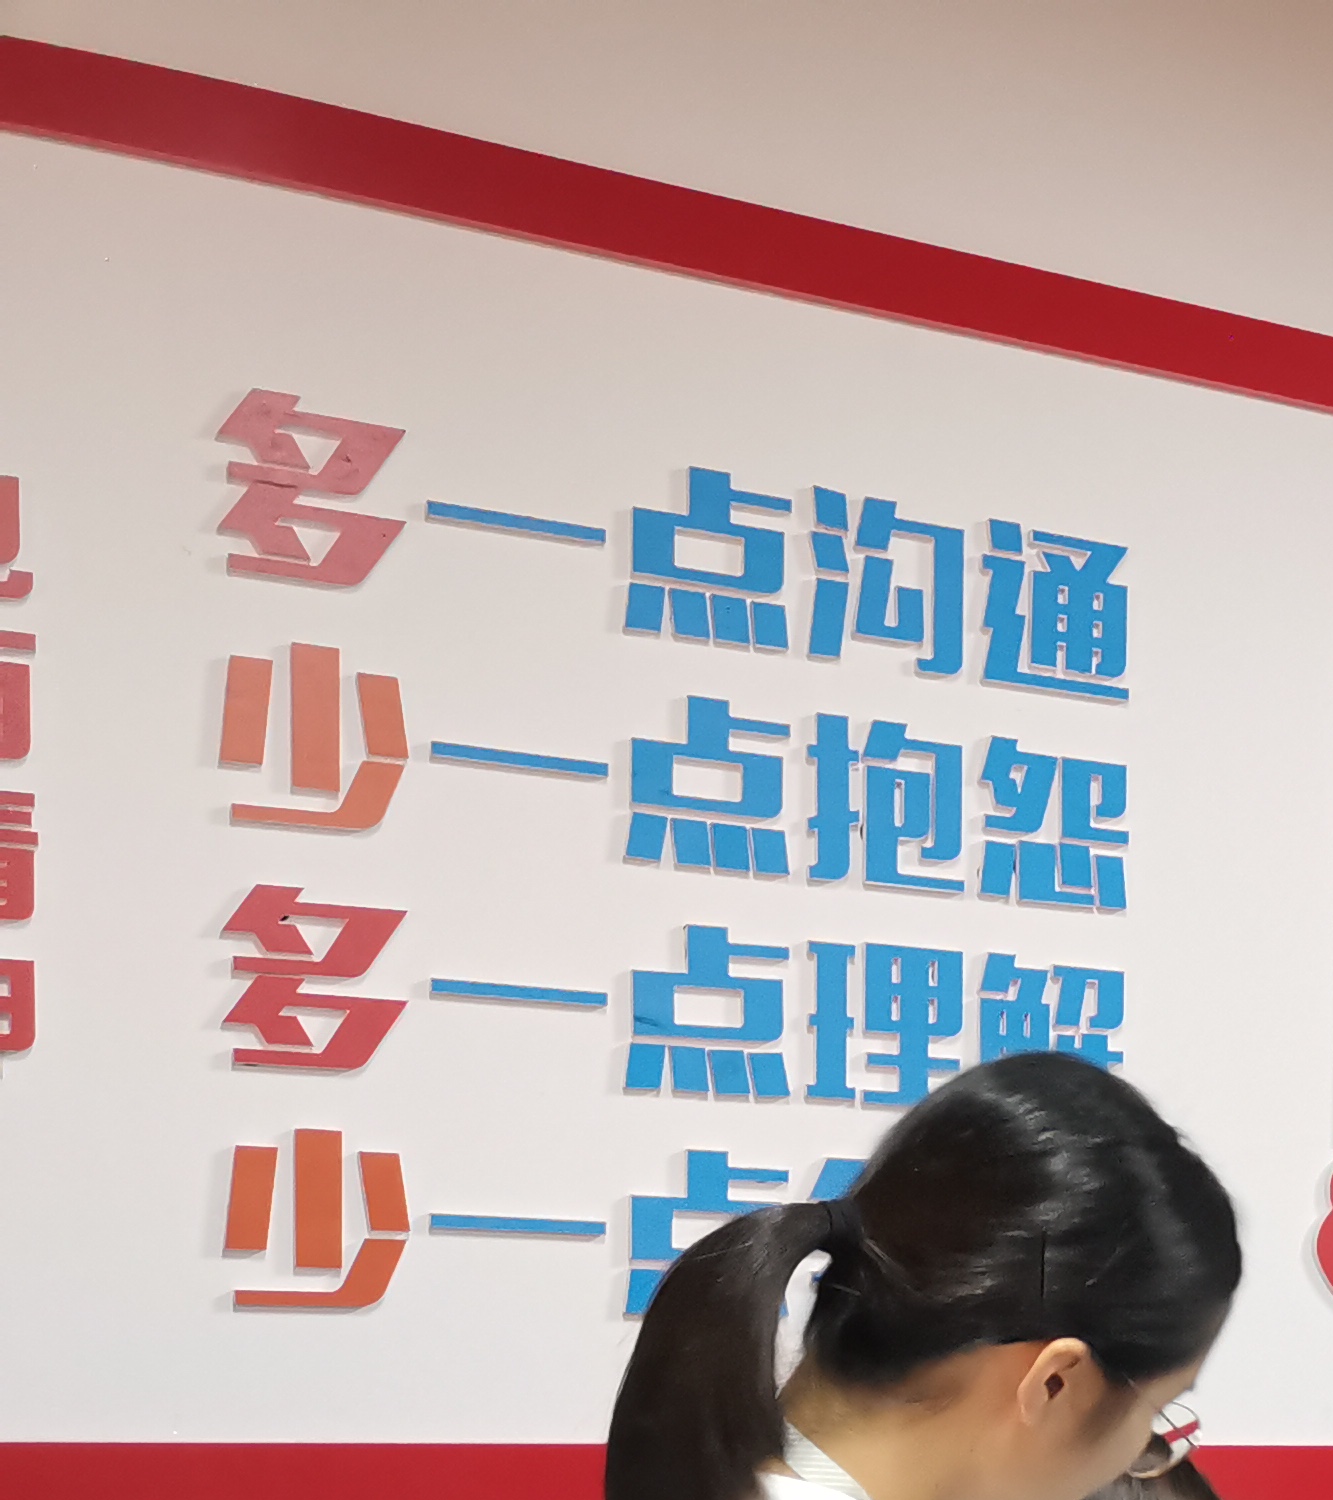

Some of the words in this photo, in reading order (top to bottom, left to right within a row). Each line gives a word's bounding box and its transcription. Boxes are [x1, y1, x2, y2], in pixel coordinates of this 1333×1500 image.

[216, 387, 1129, 702] 多一点沟通
[219, 641, 1129, 910] 少一点抱怨
[220, 884, 1126, 1104] 多一点理解
